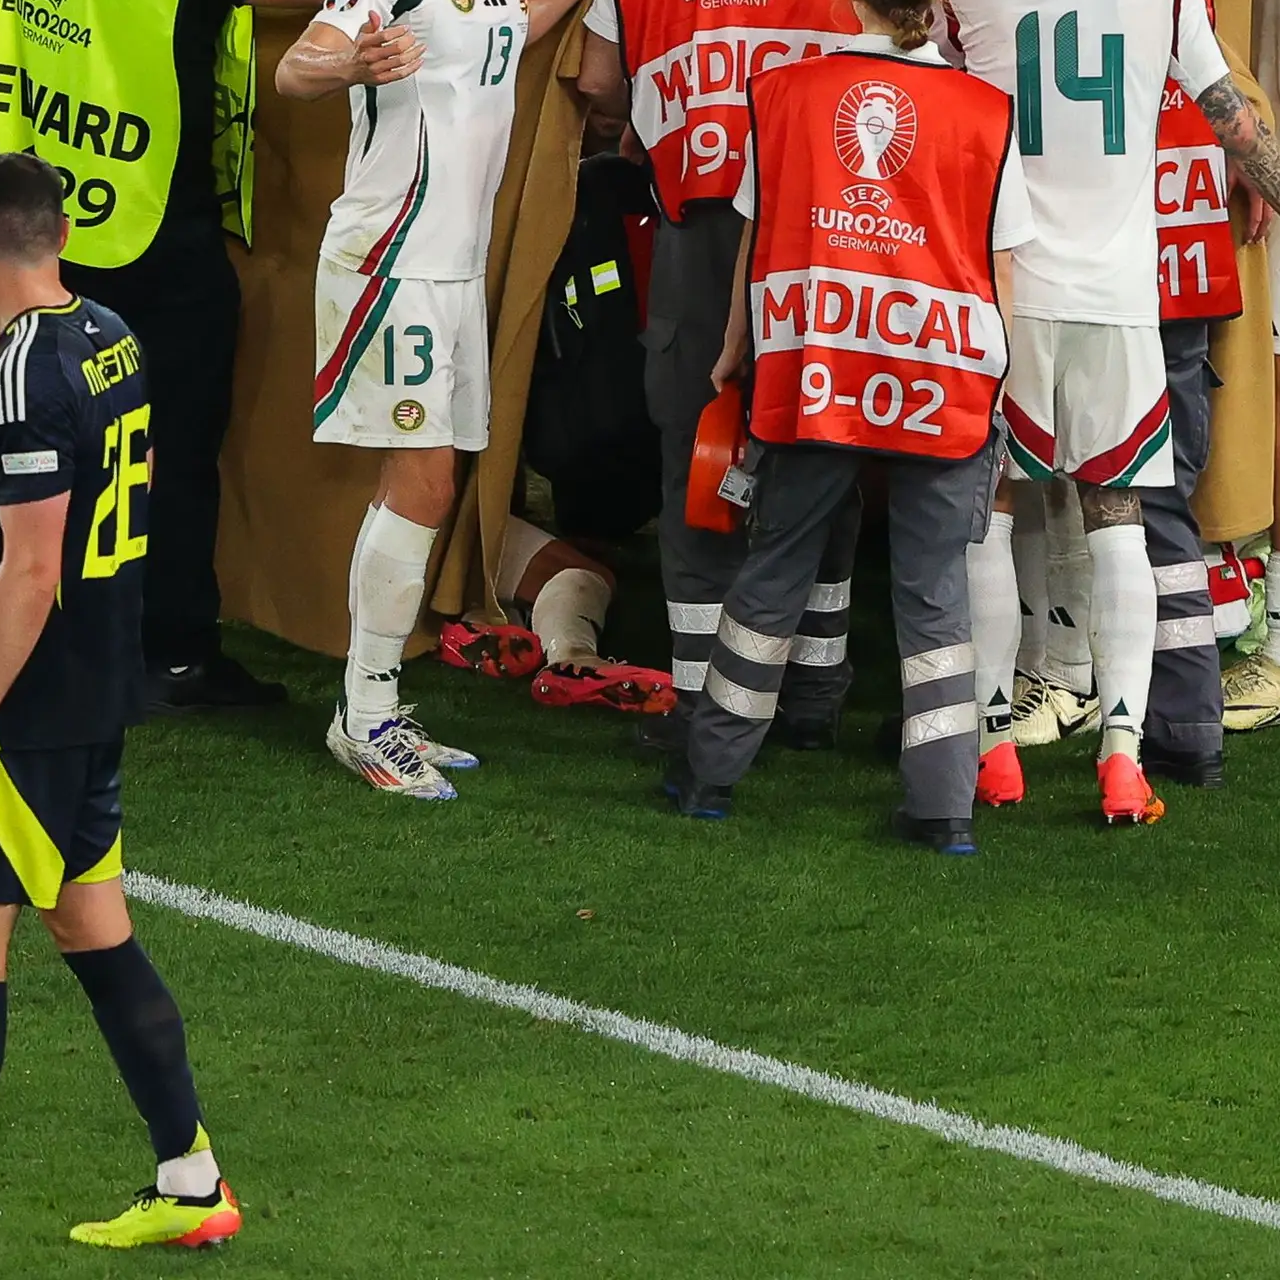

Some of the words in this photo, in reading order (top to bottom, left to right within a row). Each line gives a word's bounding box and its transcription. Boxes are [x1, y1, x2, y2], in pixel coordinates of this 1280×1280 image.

[21, 22, 65, 55] ERMANY
[480, 25, 513, 87] 13
[1015, 10, 1126, 156] 14
[842, 188, 890, 211] UEFA
[1154, 158, 1228, 216] CA
[827, 233, 901, 256] GERMANY
[762, 278, 987, 361] MDICAL
[383, 324, 434, 386] 13
[800, 362, 945, 436] 9-02
